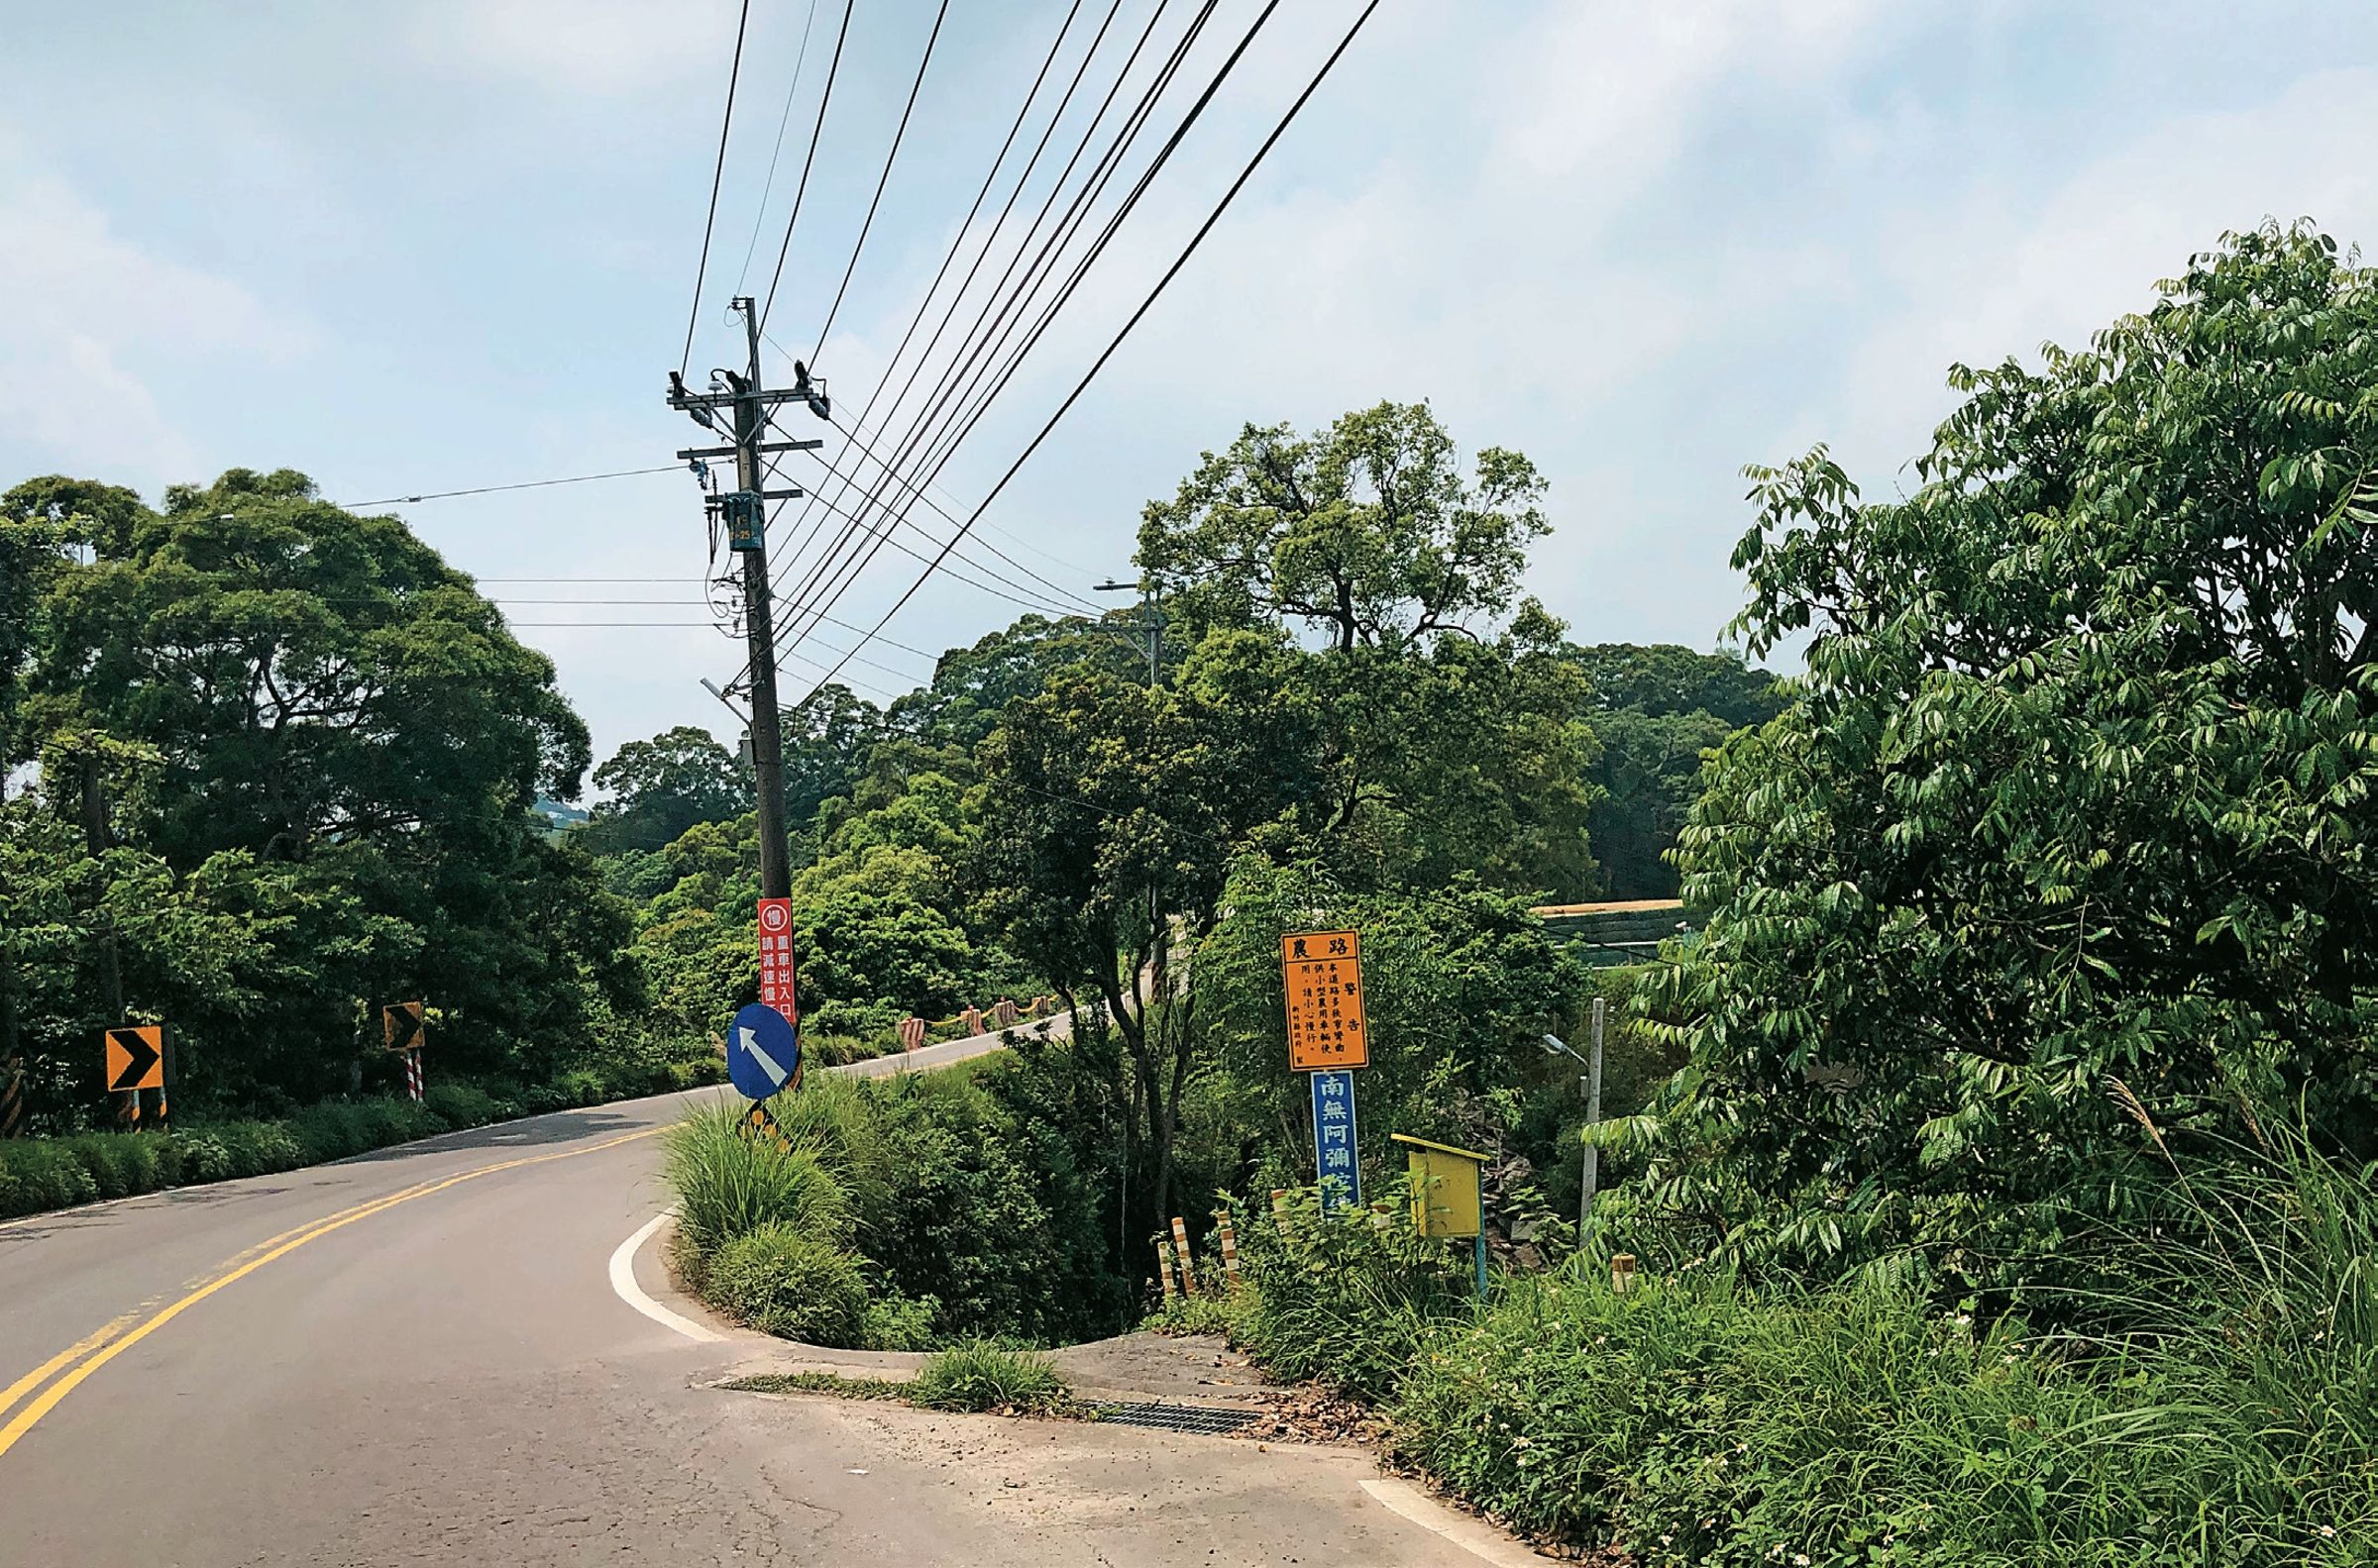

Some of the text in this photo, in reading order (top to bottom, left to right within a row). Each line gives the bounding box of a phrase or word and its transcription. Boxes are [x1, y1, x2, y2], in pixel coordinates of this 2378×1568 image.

[767, 909, 782, 926] 慢
[1292, 938, 1349, 959] 農路
[762, 937, 776, 1009] 請減速慢
[1344, 982, 1360, 1032] 警告
